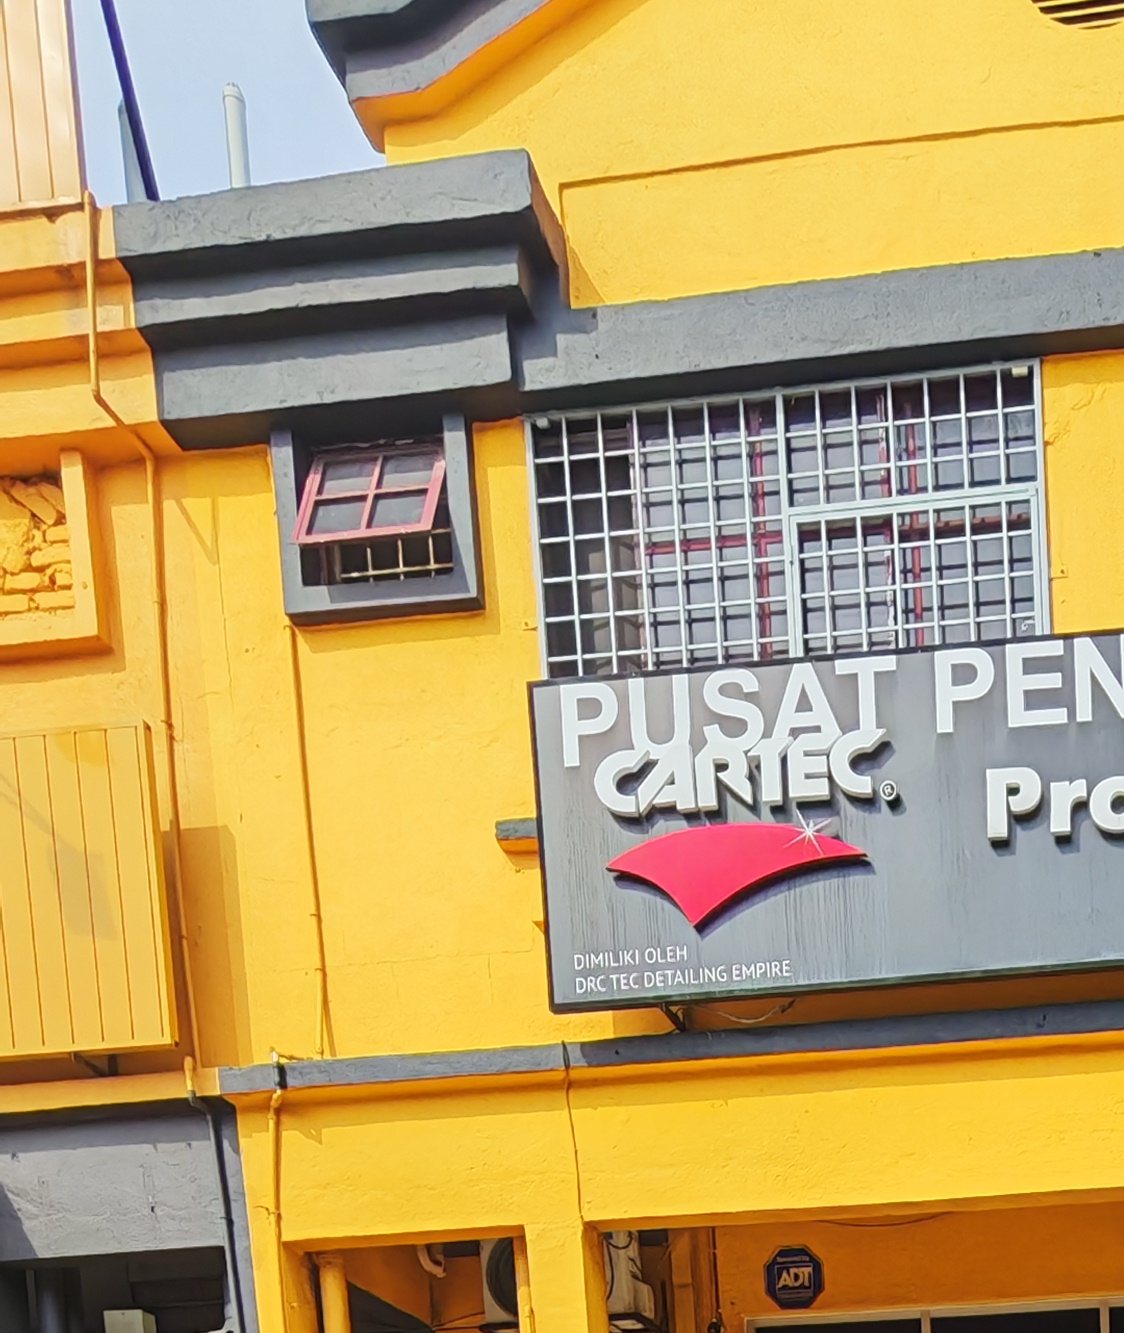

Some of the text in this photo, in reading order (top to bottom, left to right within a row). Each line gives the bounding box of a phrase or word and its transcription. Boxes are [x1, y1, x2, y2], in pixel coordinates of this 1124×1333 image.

[559, 655, 897, 768] PUSAT
[573, 945, 688, 971] DIMILIKI OLEH
[575, 960, 792, 994] DRC TEC DETAILING EMPIRE
[777, 1267, 812, 1288] ADT
